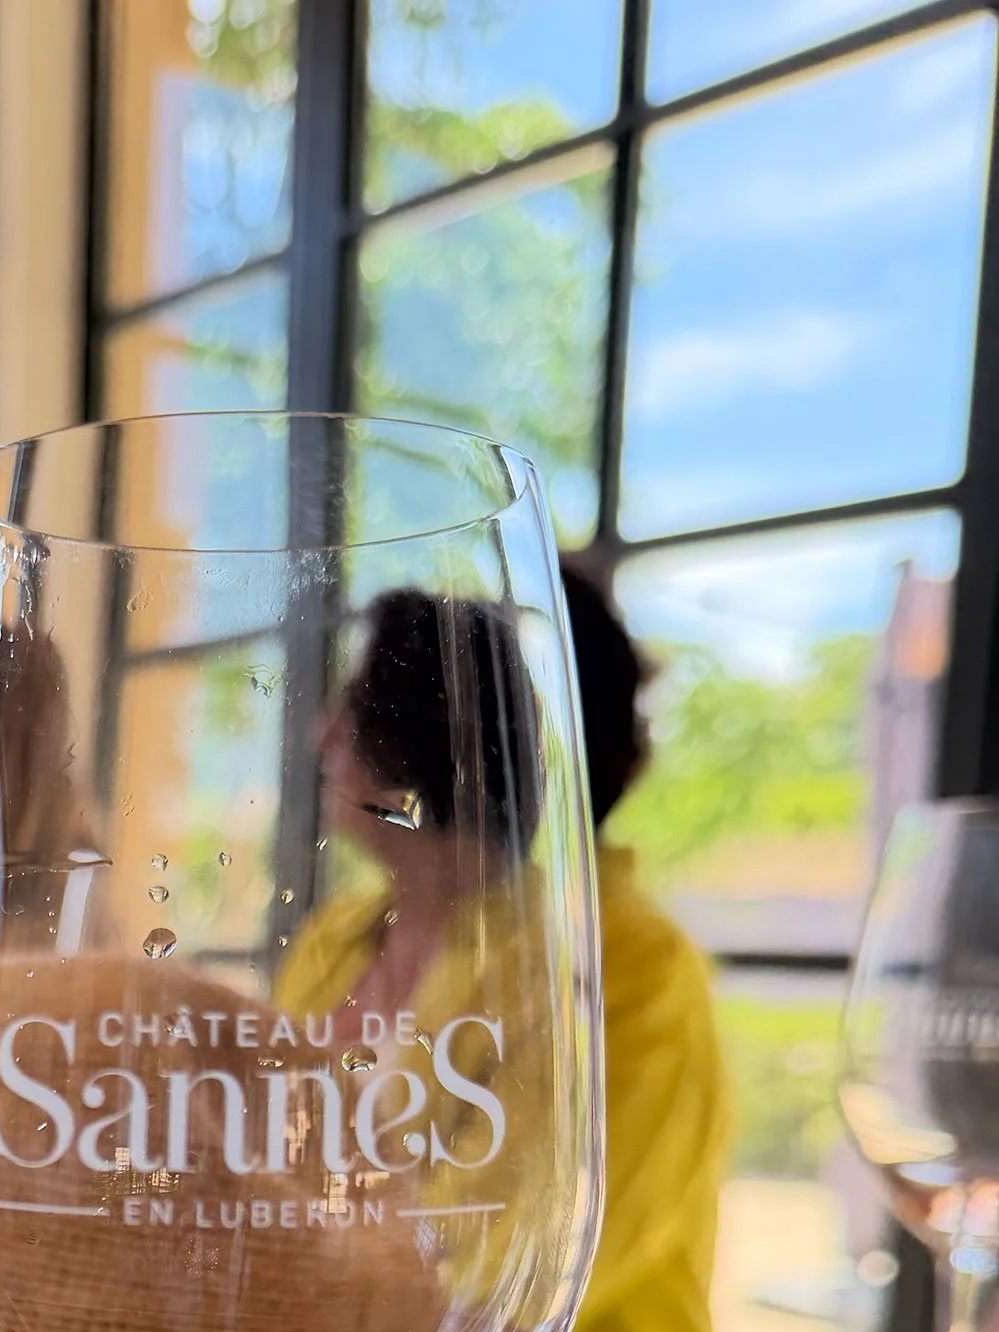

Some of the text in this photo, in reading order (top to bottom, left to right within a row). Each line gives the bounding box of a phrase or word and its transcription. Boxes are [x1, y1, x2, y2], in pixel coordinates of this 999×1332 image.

[99, 1006, 417, 1049] CHÂTEAU DE
[122, 1198, 385, 1229] EN LUBERON
